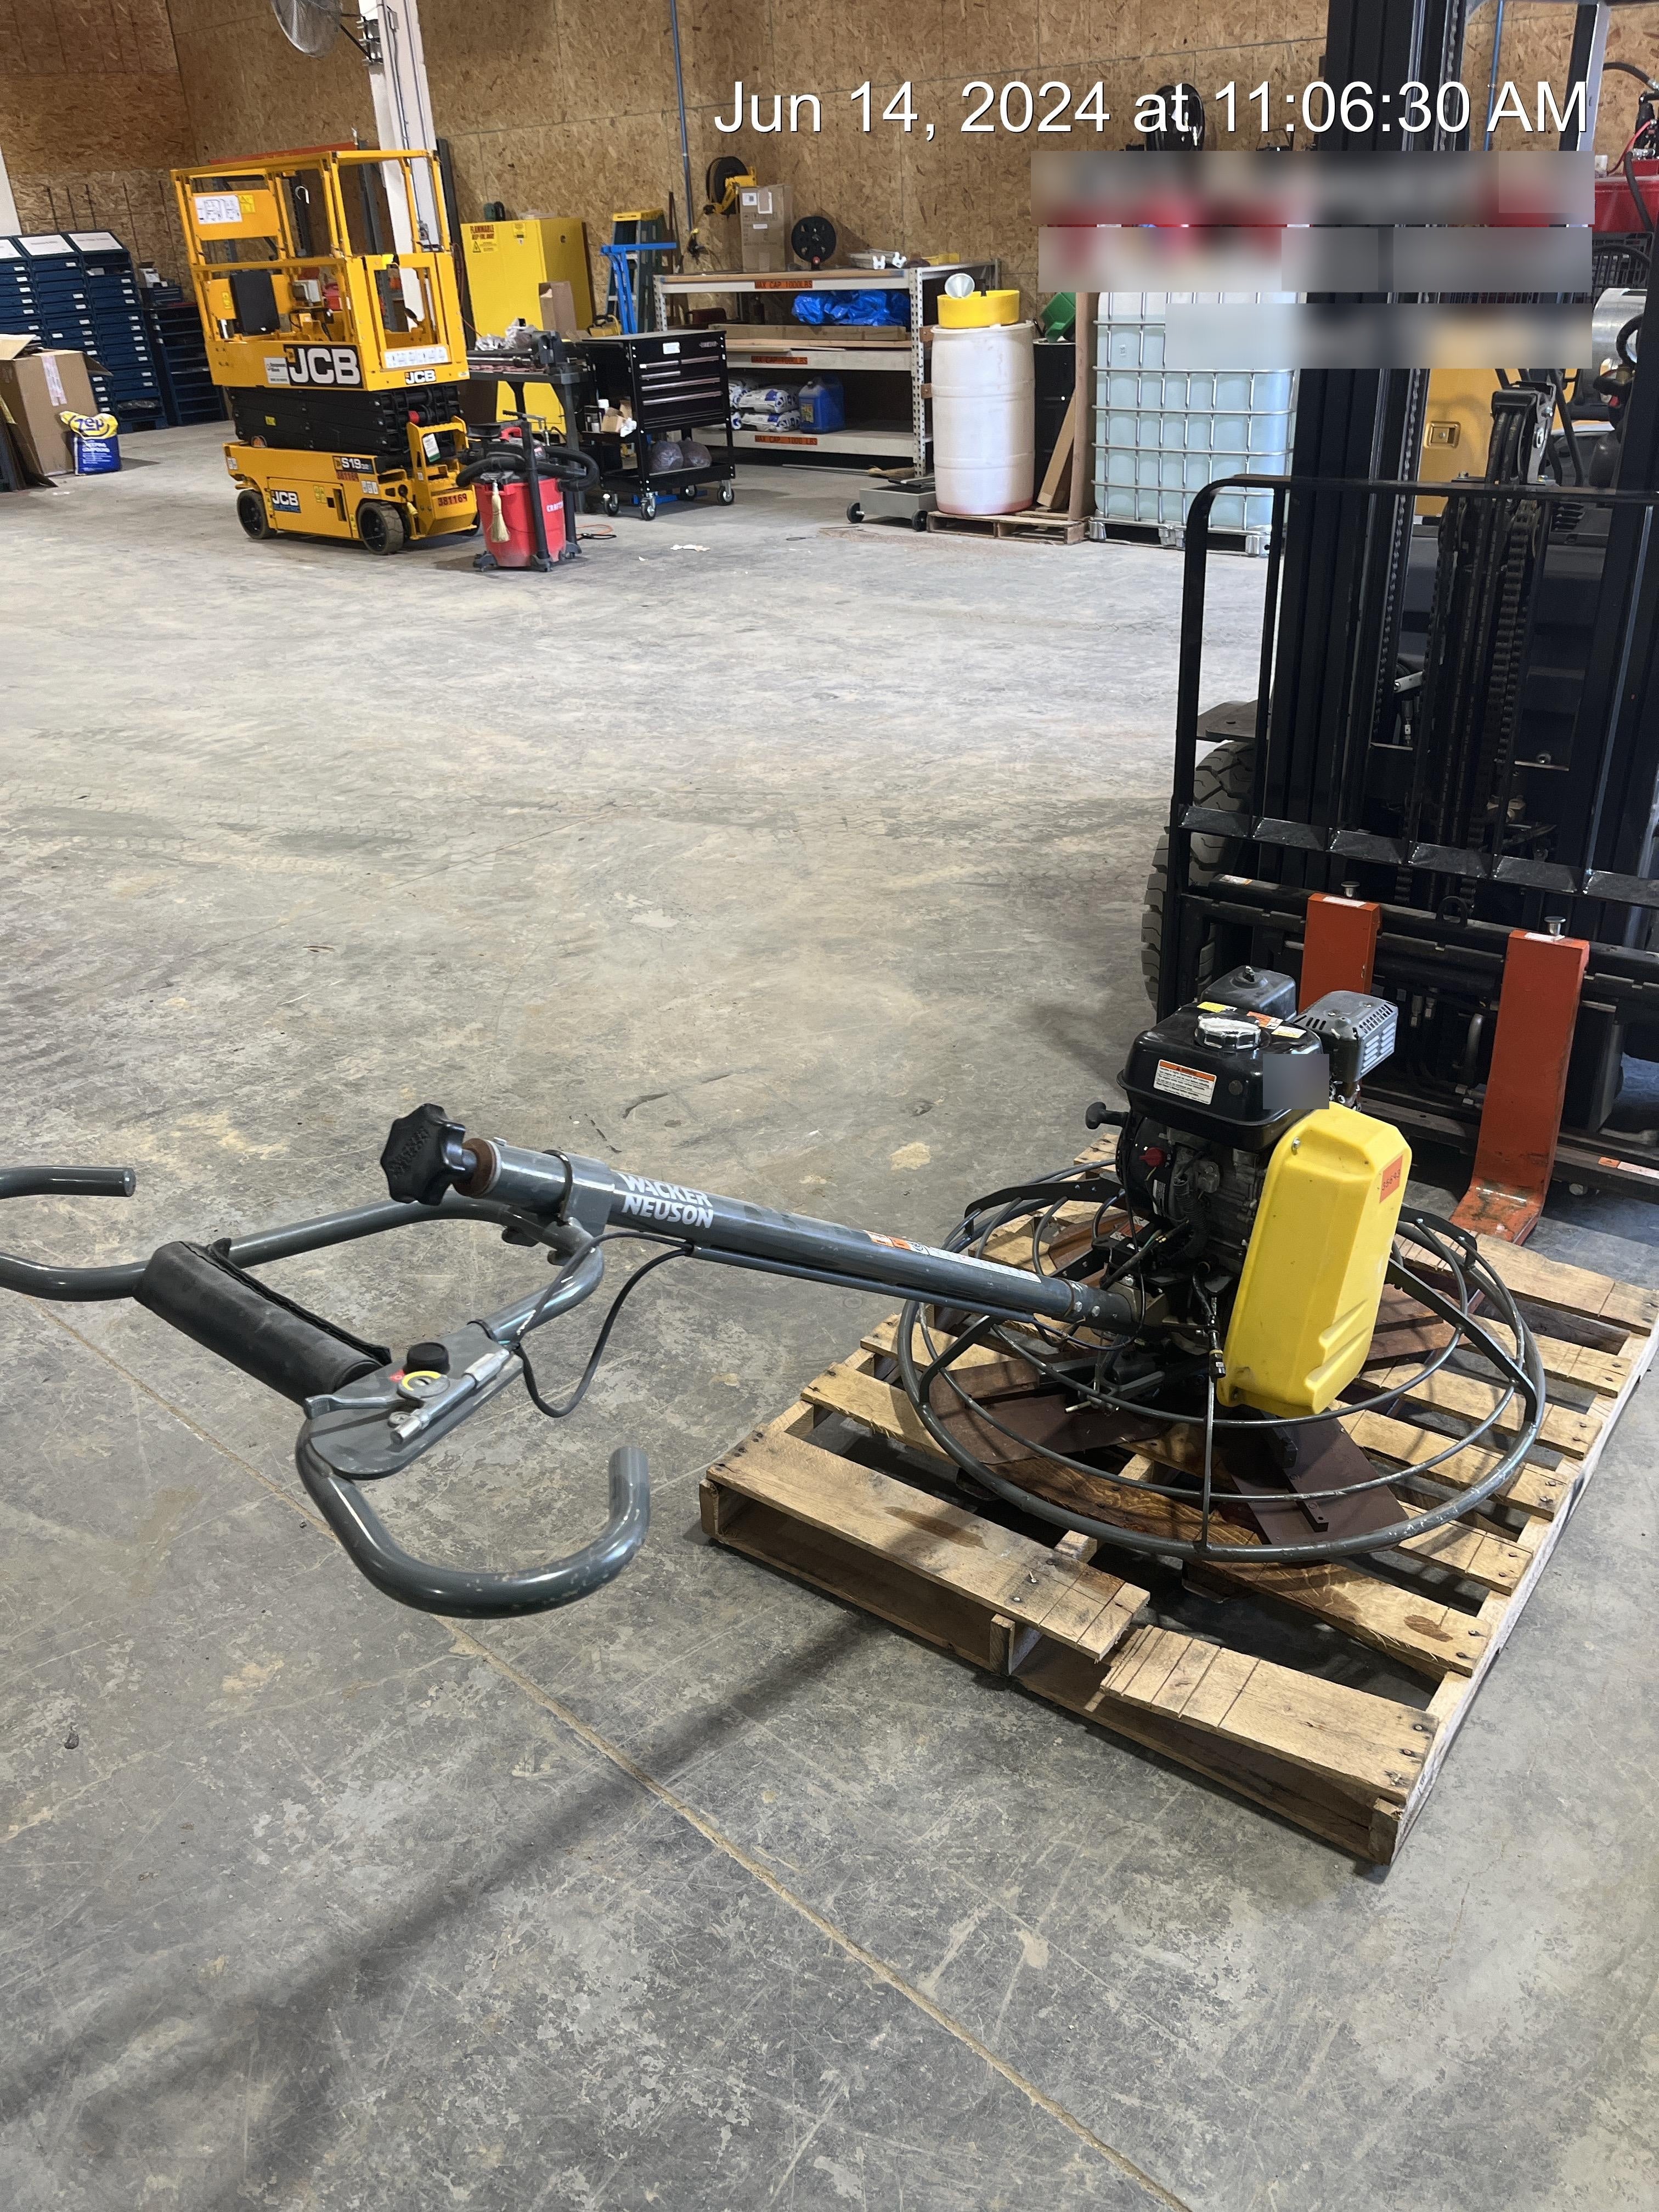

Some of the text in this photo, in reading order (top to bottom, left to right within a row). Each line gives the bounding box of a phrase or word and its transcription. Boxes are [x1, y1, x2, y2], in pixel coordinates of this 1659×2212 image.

[289, 348, 360, 385] JCB
[405, 370, 436, 384] JCB
[272, 491, 299, 506] JCB
[617, 1172, 714, 1207] WACKER
[621, 1194, 714, 1229] NEUSON
